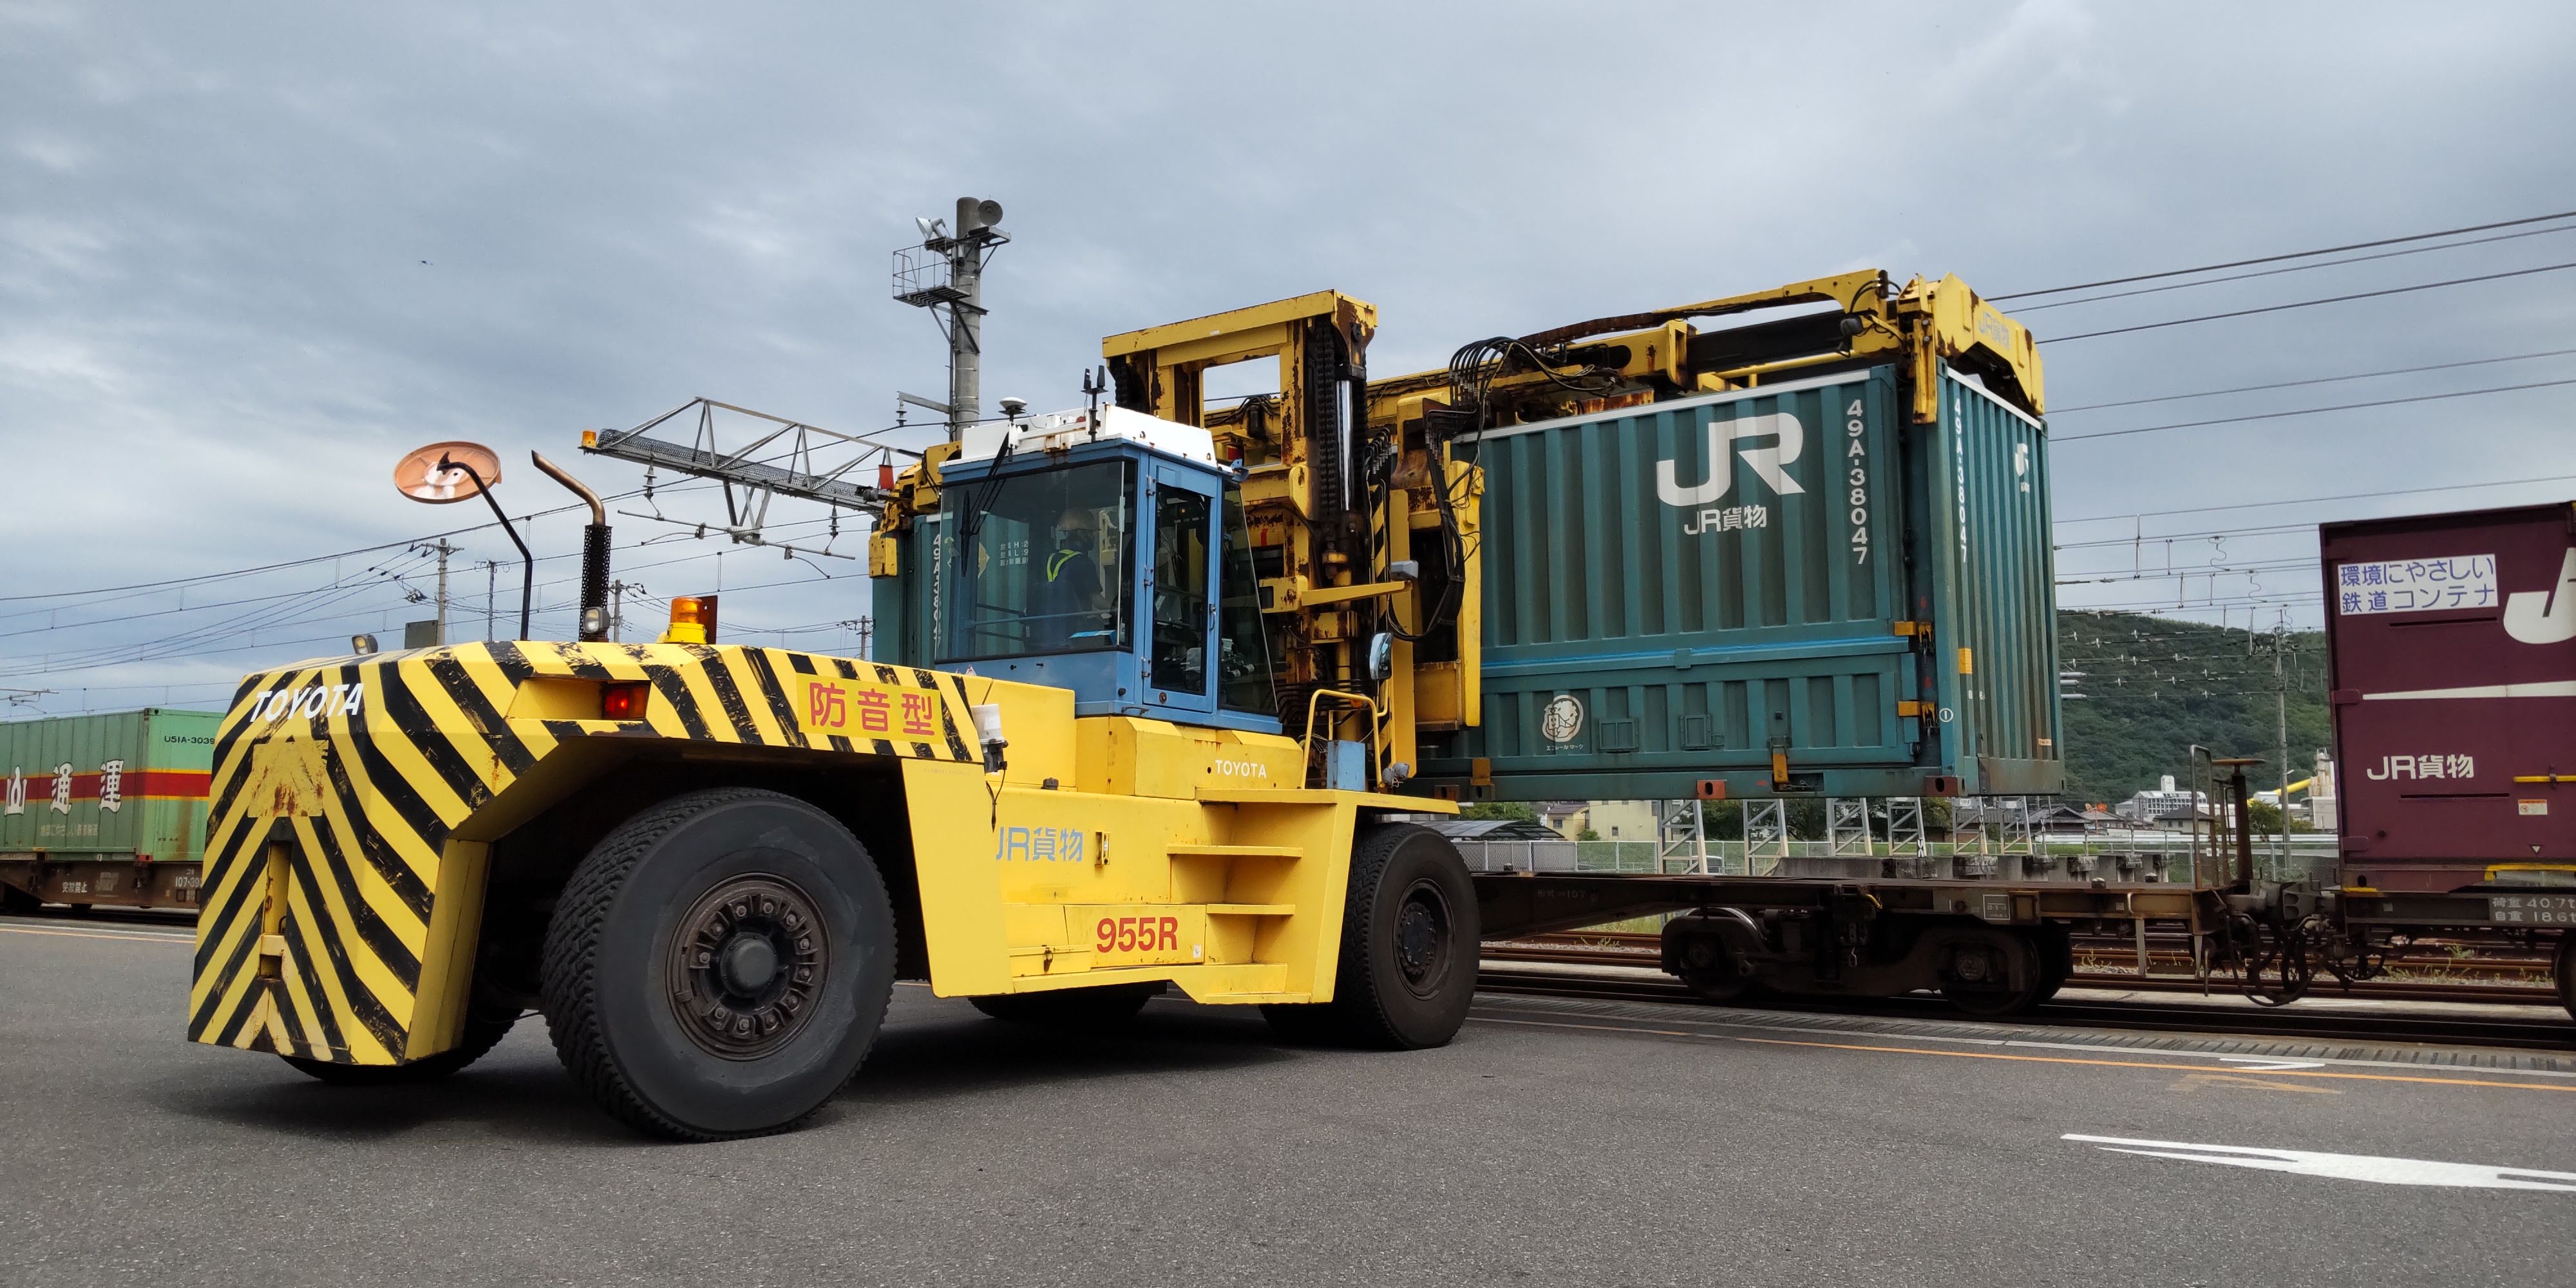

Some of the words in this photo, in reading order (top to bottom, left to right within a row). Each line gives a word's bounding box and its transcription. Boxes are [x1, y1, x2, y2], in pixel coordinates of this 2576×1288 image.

[1656, 412, 1806, 507] JR
[1847, 399, 1868, 565] 49A-38047
[1954, 398, 1967, 563] 49A-38047
[1683, 504, 1767, 535] JR貨物
[2341, 557, 2494, 587] 環境にやさしい
[2342, 583, 2495, 613] 鉄道コンテナ
[250, 683, 365, 723] TOYOTA
[810, 682, 935, 736] 防音型
[1215, 759, 1267, 779] TOYOTA
[2367, 754, 2474, 781] JR貨物
[996, 826, 1084, 862] JR貨物
[1097, 916, 1177, 953] 955R
